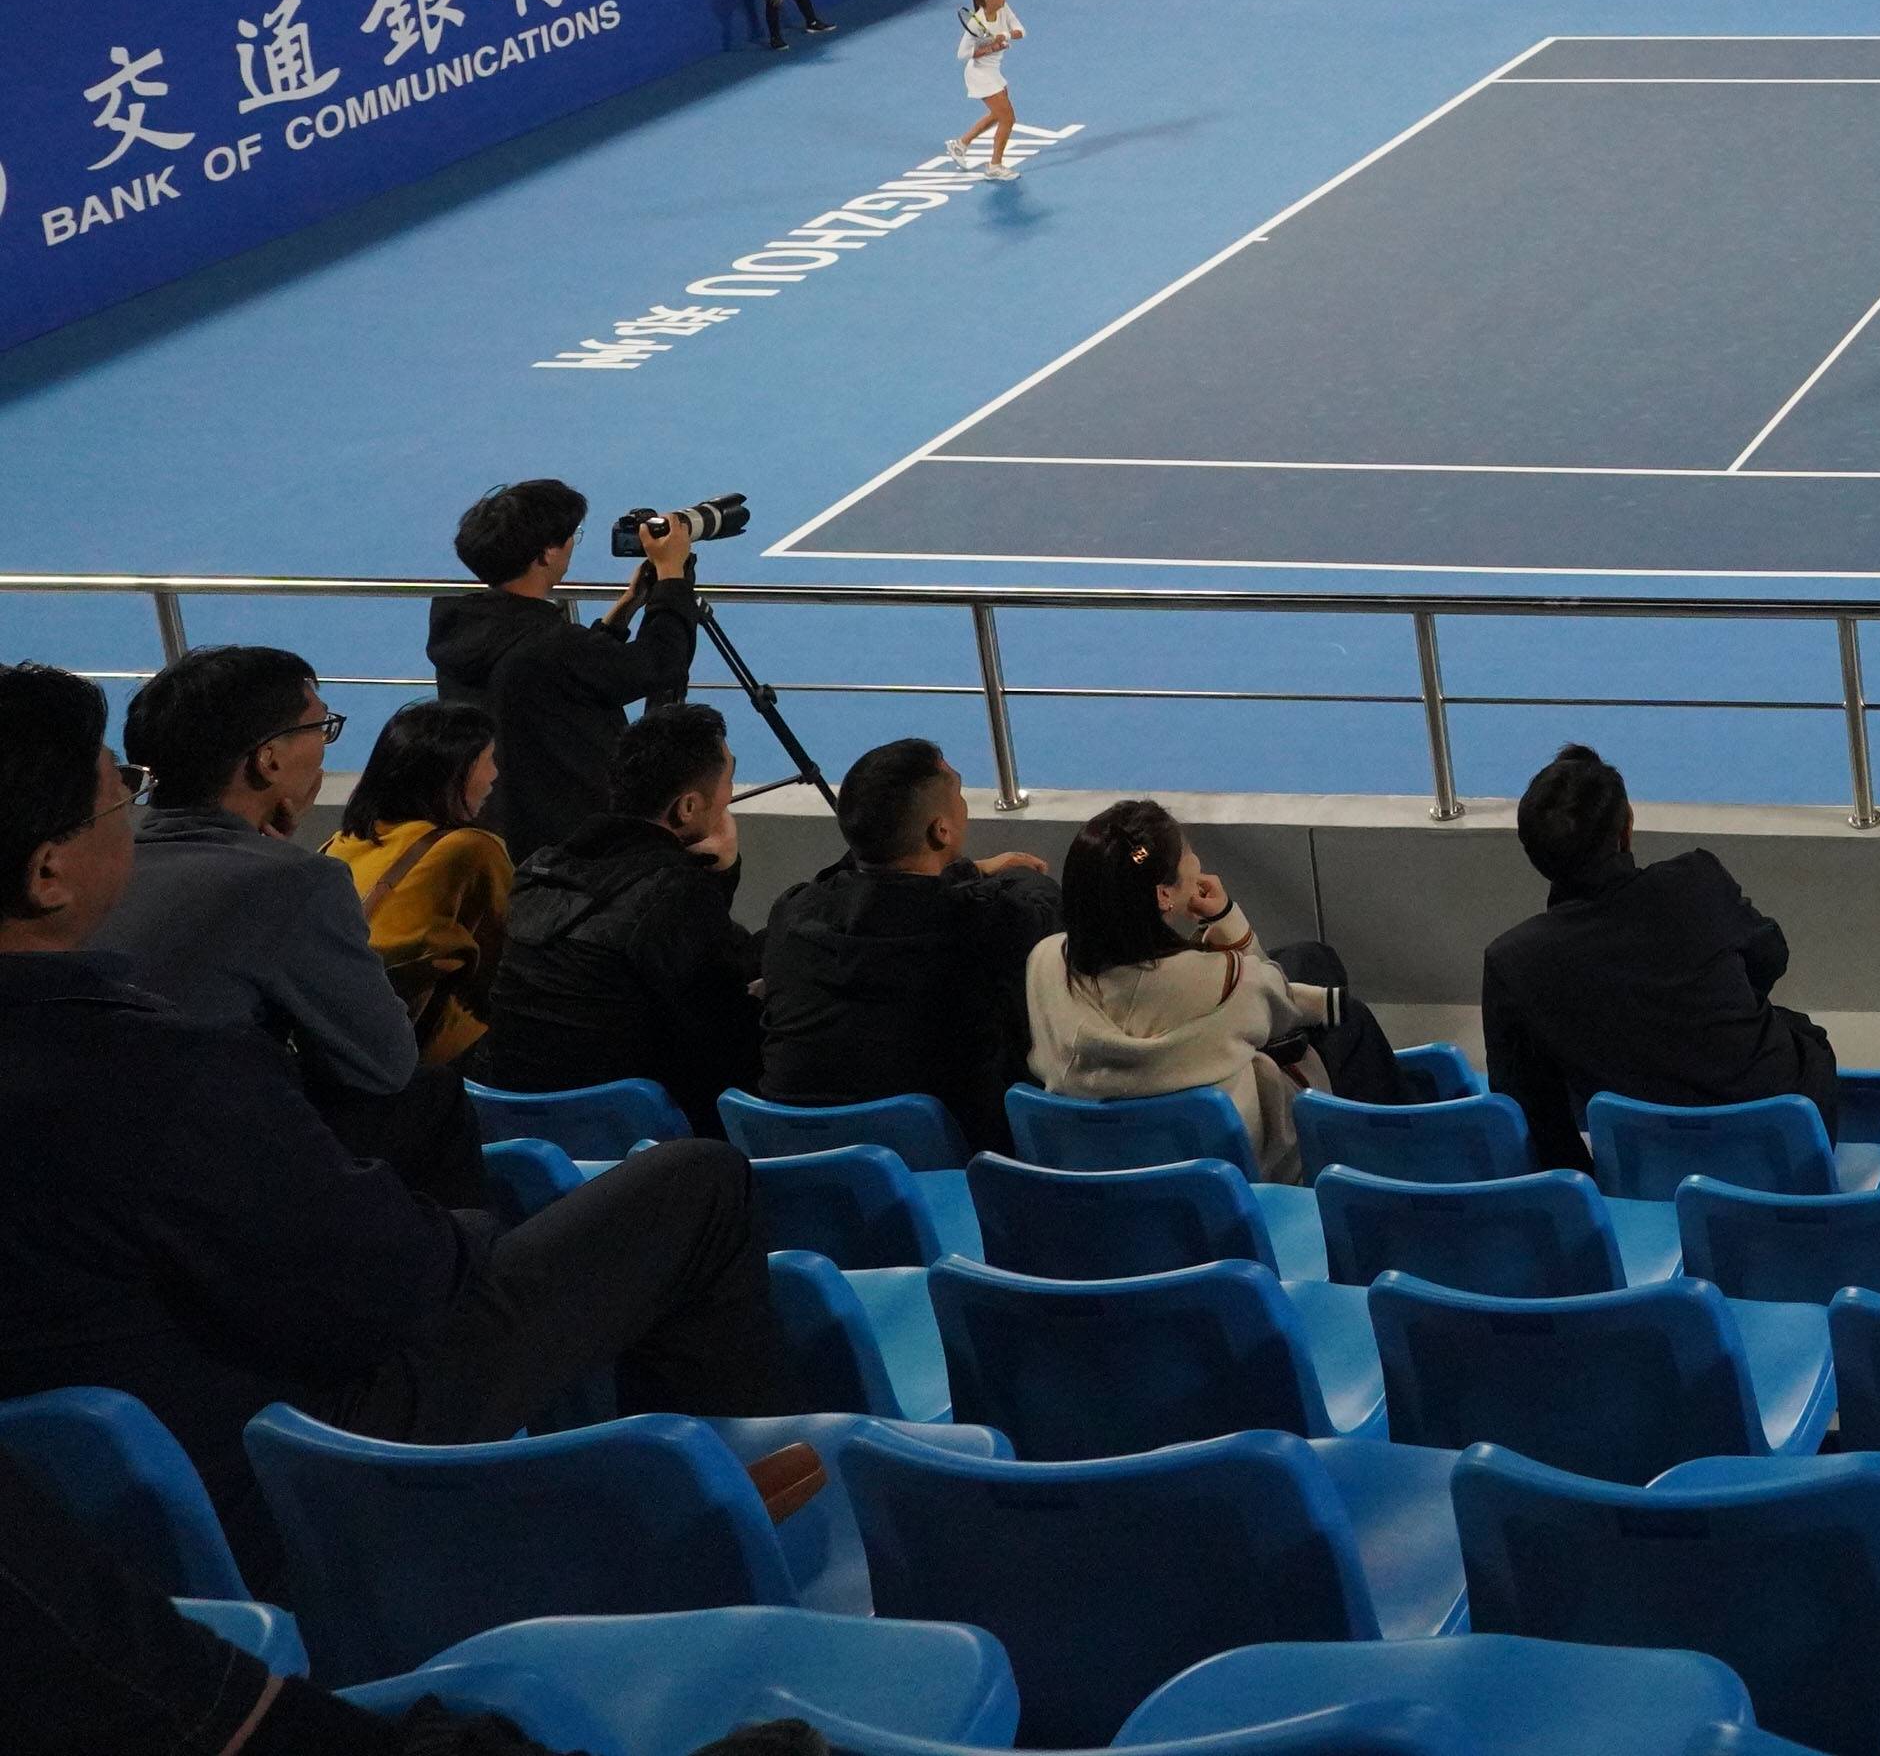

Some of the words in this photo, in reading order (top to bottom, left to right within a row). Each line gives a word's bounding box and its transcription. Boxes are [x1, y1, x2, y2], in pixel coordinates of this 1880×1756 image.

[41, 162, 181, 246] BANK
[203, 133, 262, 182] OF
[684, 122, 1087, 297] ZHENGZHOU
